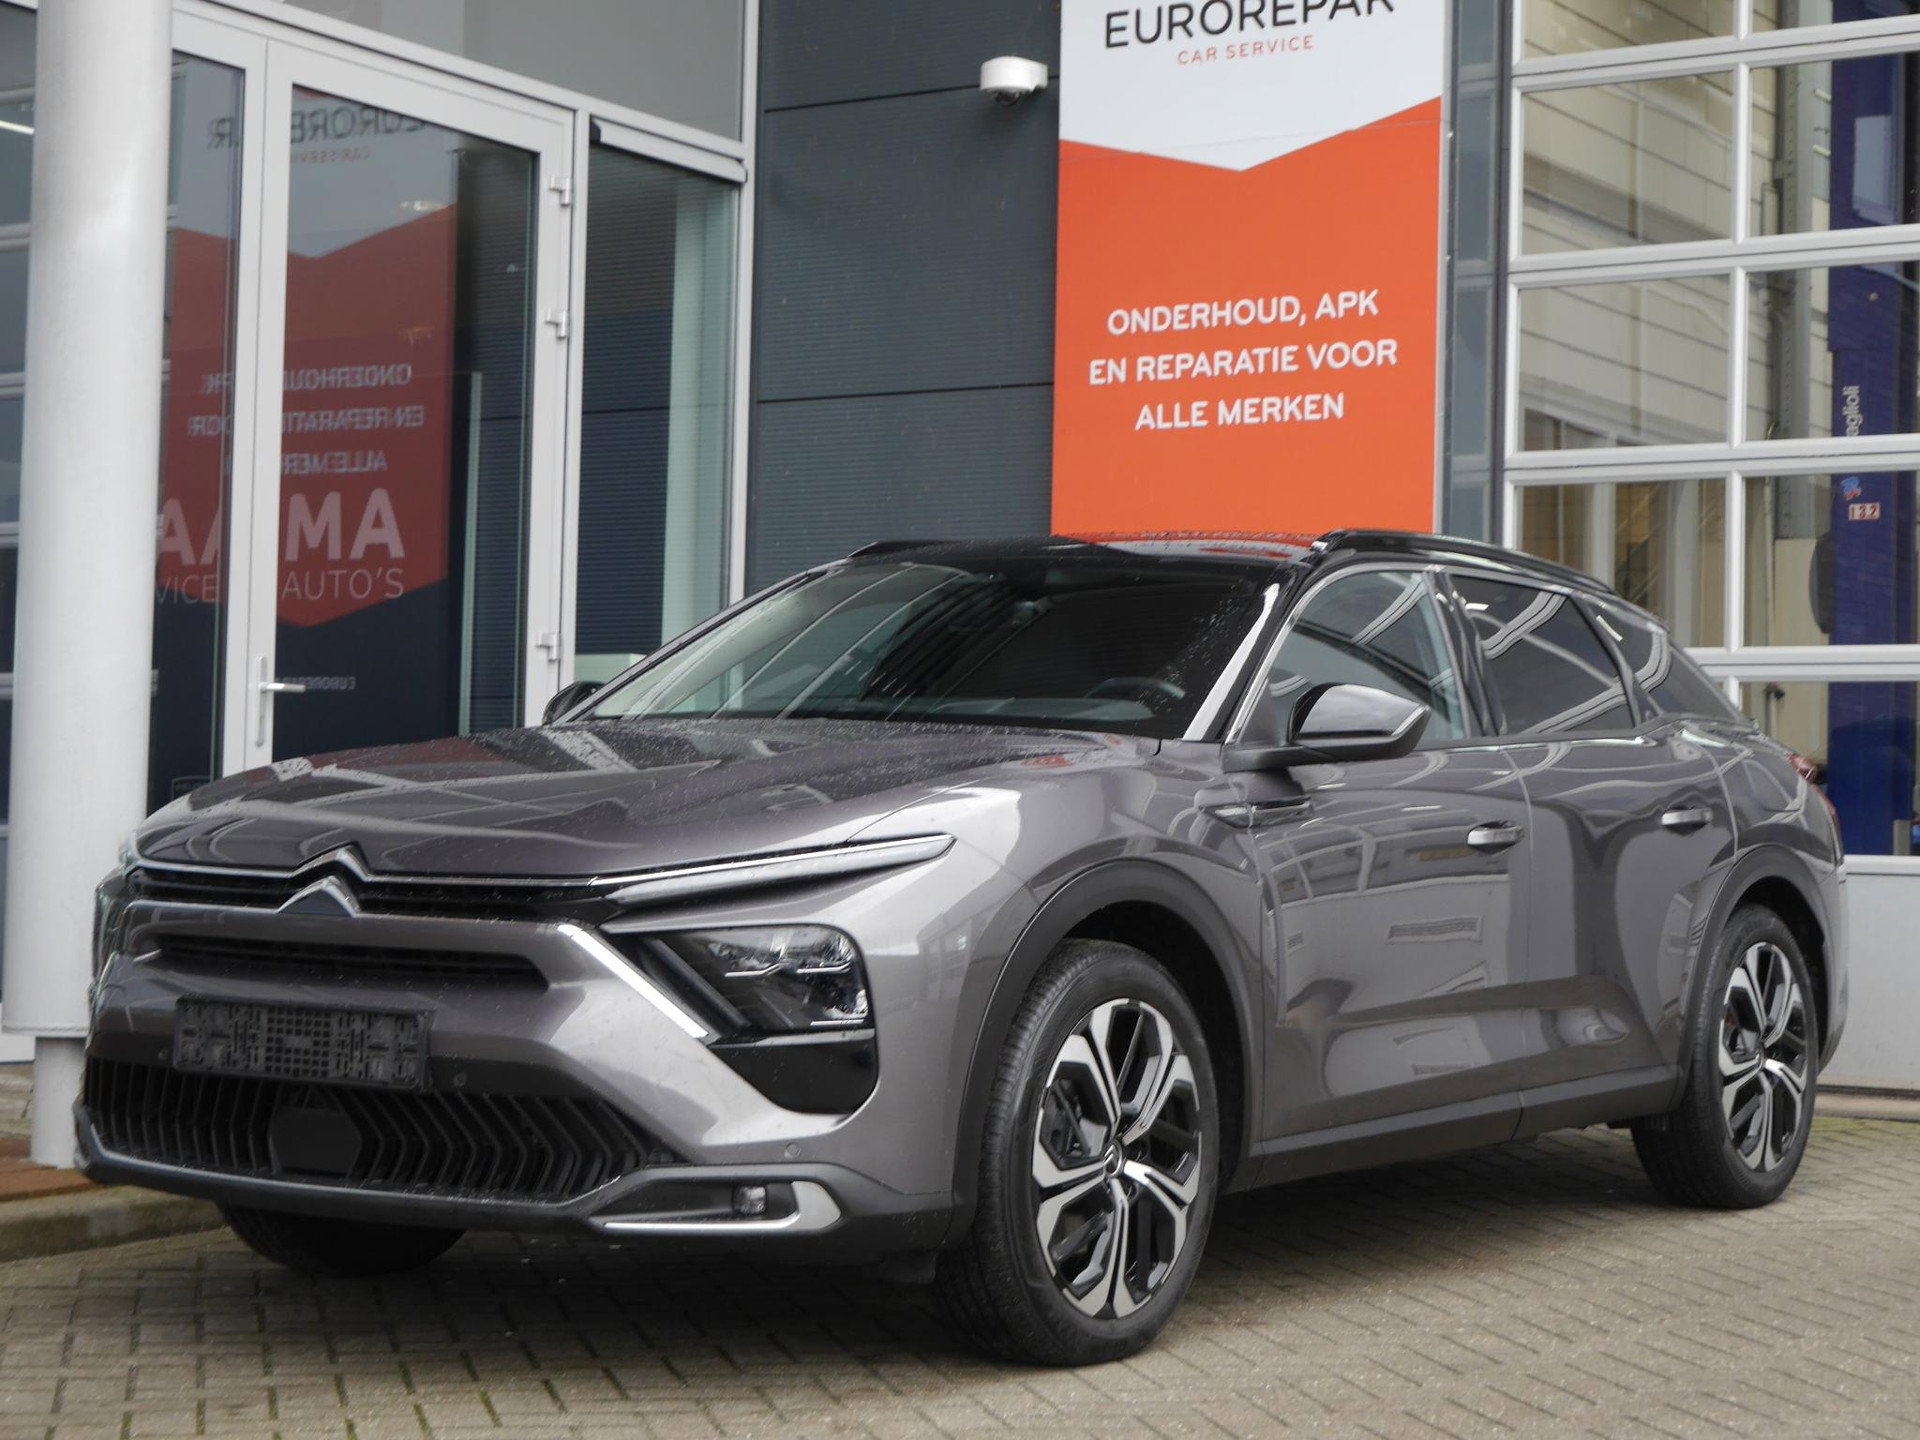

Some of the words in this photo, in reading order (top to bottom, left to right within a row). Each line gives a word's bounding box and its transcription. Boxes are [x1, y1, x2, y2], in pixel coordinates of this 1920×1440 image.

[1177, 47, 1218, 65] CAR
[1225, 34, 1315, 60] SERVICE
[1106, 295, 1307, 335] ONDERHOUD,
[1315, 289, 1380, 321] APK
[1089, 358, 1127, 386] EN
[1136, 345, 1299, 382] REPARATIE
[1306, 338, 1399, 370] VOOR
[1135, 400, 1209, 431] ALLE
[1217, 392, 1345, 426] MERKEN
[281, 568, 405, 601] AUTO'S
